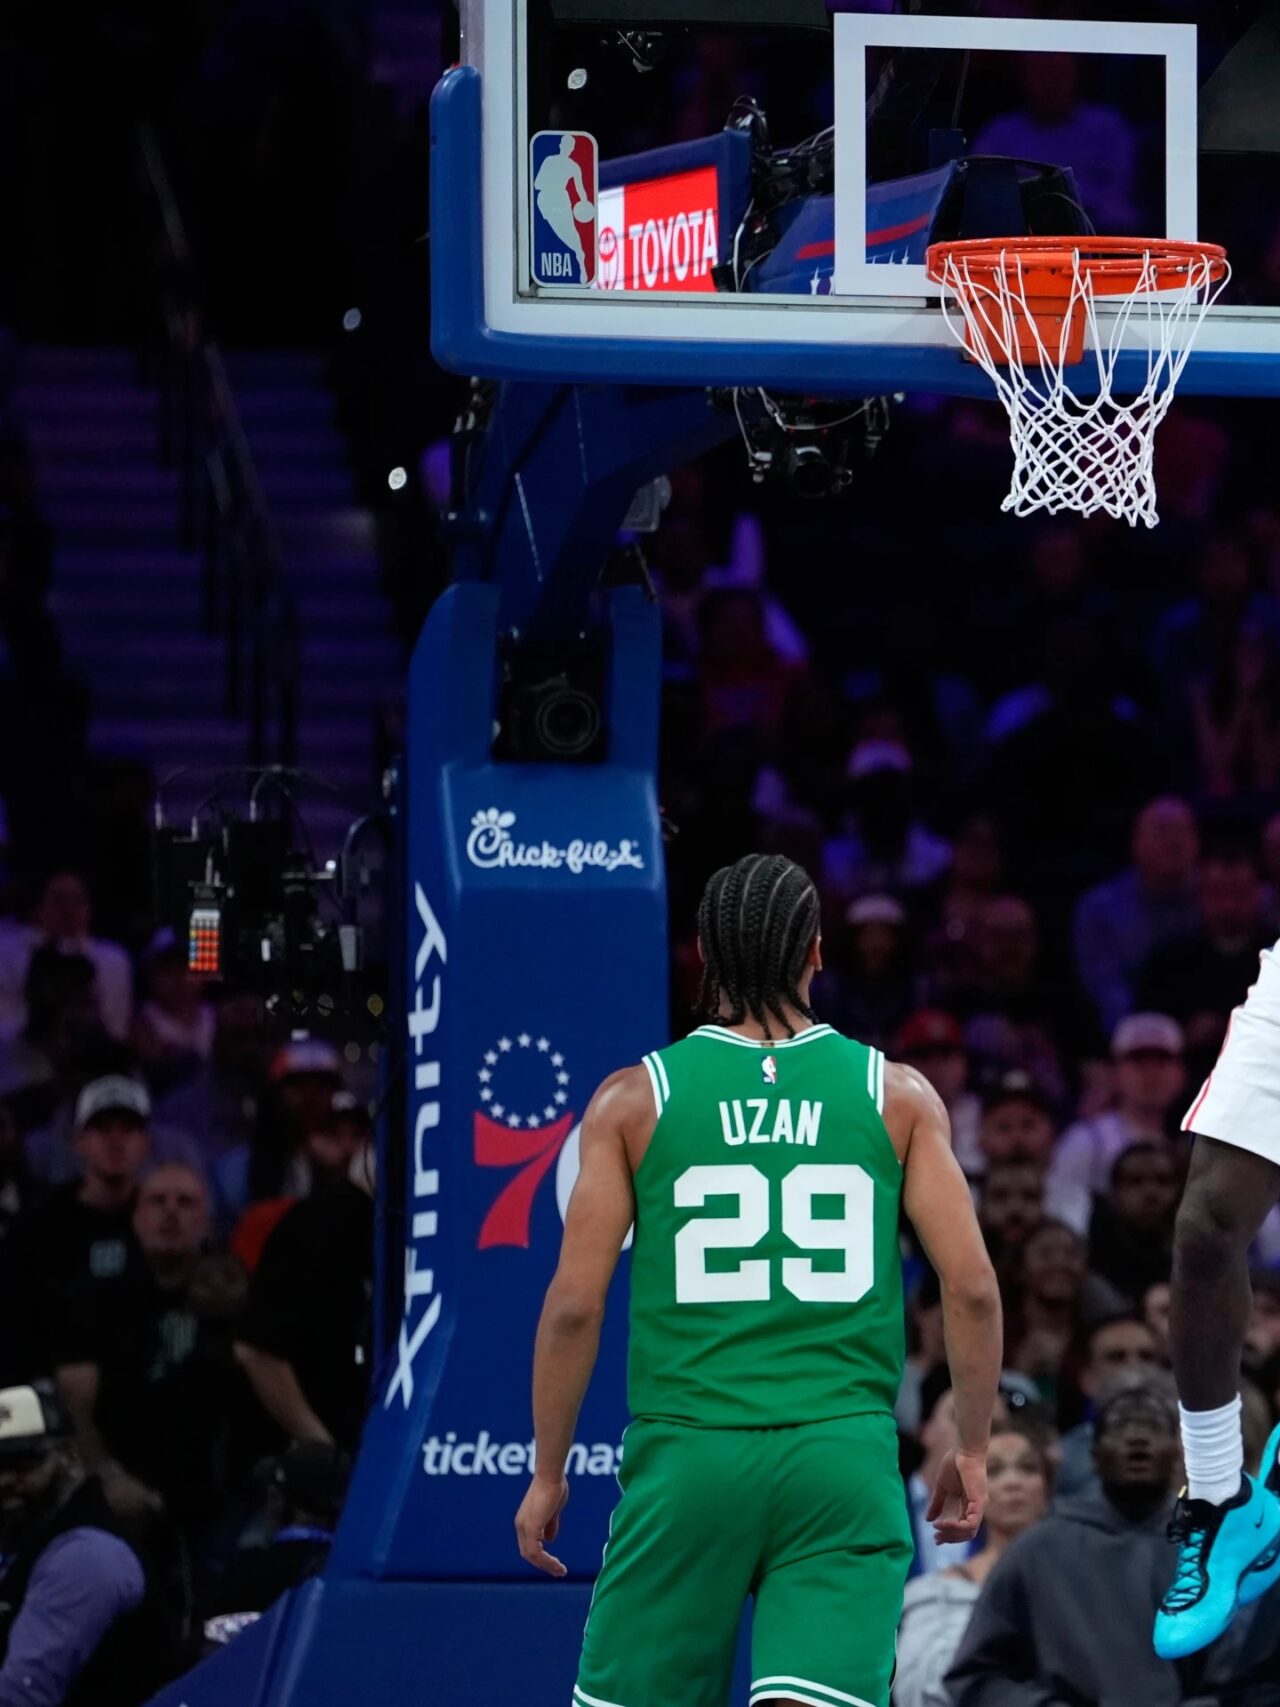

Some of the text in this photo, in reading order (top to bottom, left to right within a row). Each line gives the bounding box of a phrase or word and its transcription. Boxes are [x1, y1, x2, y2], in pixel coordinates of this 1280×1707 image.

[541, 252, 572, 277] NBA
[629, 208, 717, 290] TOYOTA
[719, 1098, 823, 1146] UZAN
[473, 1111, 634, 1251] 7
[674, 1164, 874, 1303] 29
